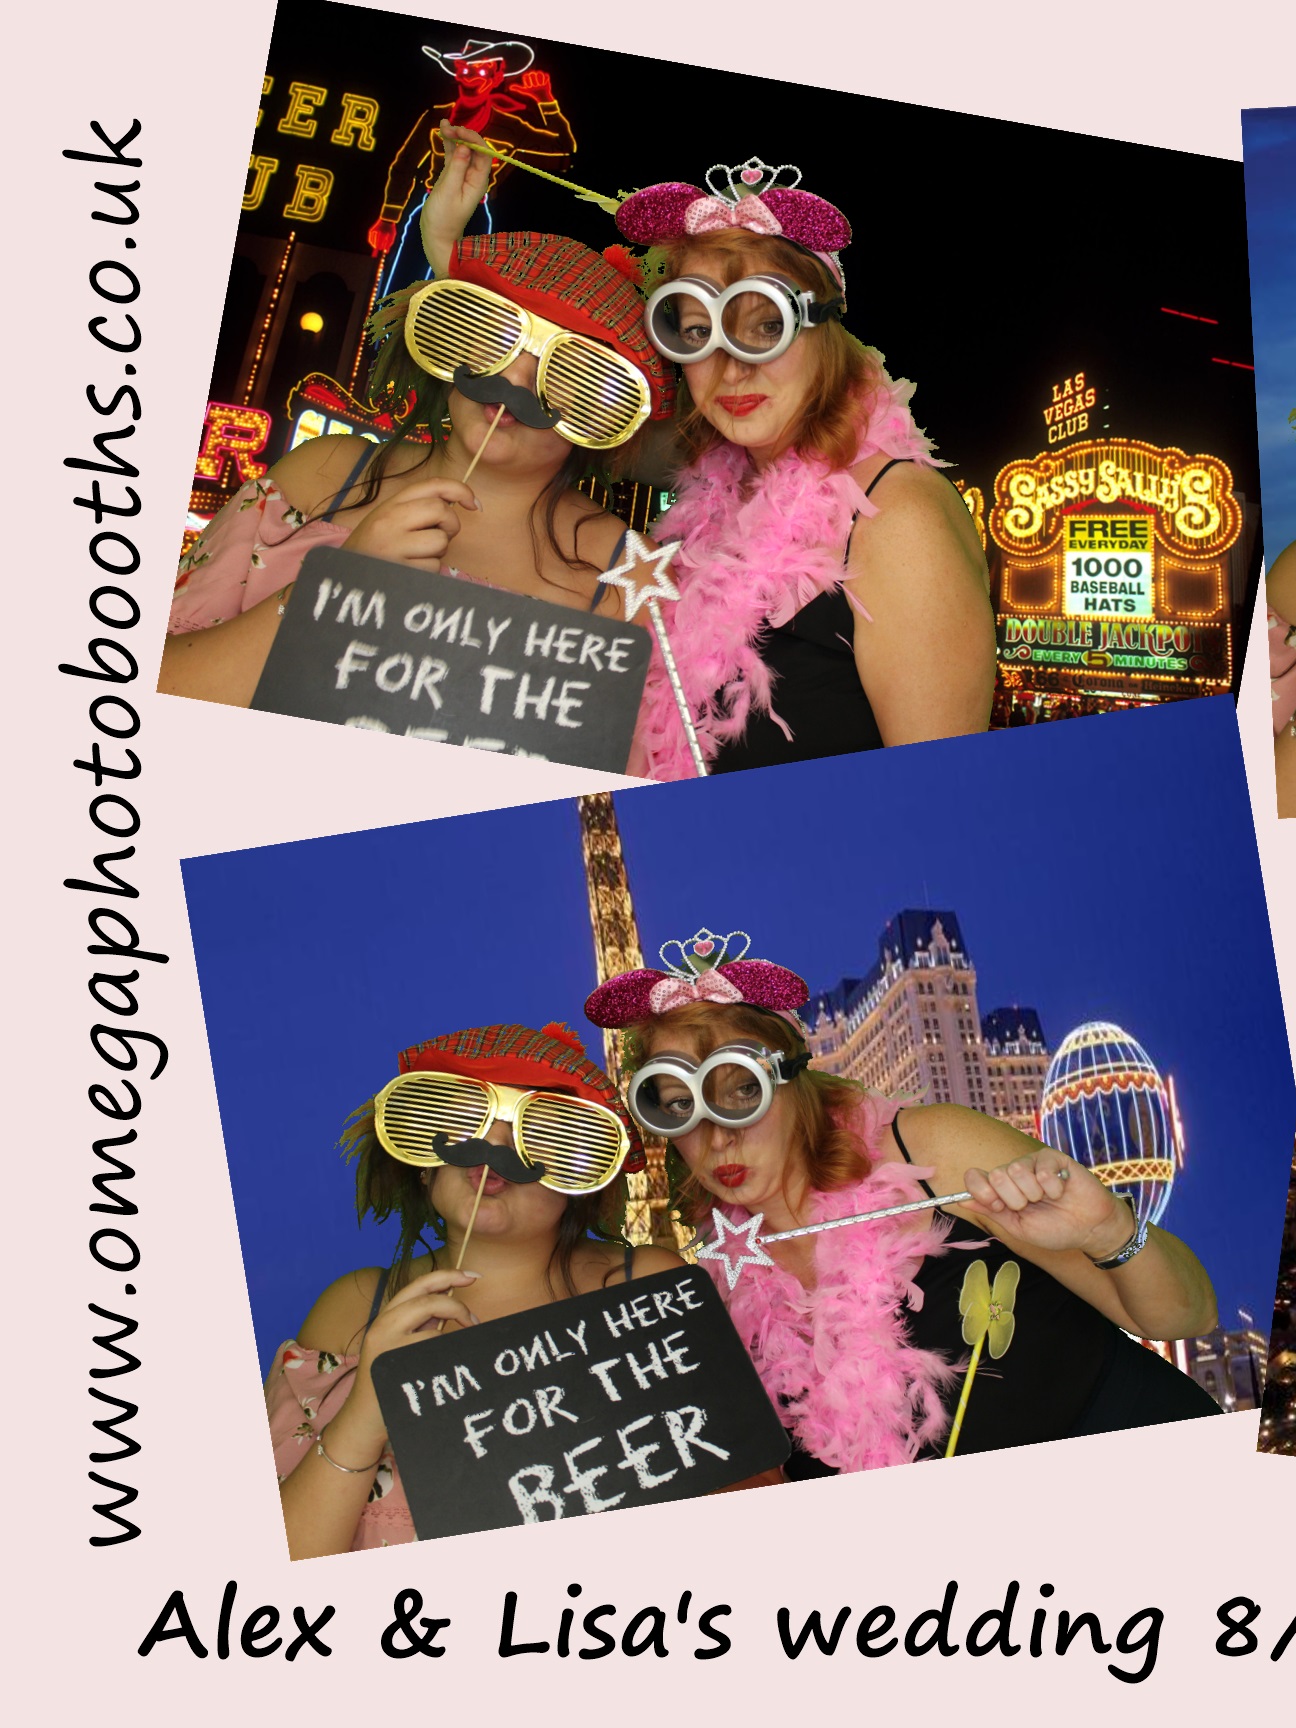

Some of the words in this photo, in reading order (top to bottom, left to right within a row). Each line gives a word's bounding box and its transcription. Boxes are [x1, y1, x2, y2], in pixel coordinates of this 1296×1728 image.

[256, 75, 380, 152] ER
[1052, 372, 1085, 403] LAS
[1043, 388, 1096, 426] VEGAS
[1048, 413, 1089, 444] CLUB
[1069, 519, 1148, 539] FREE
[1069, 540, 1148, 549] EVERYDAY
[1071, 557, 1143, 578] 1000
[1070, 581, 1145, 595] BASEBALL
[1084, 598, 1136, 612] HATS
[313, 577, 386, 629] I'M
[403, 602, 512, 655] ONLY
[523, 621, 635, 673] HERE
[1005, 618, 1093, 647] DOUBLE
[1032, 651, 1081, 664] EVERY
[1086, 650, 1112, 668] 5
[1113, 655, 1188, 671] MINUTES
[334, 639, 450, 710] FOR
[480, 664, 591, 728] THE
[401, 1364, 482, 1416] I'M
[494, 1320, 589, 1376] ONLY
[602, 1278, 704, 1338] HERE
[463, 1386, 579, 1458] FOR
[589, 1330, 700, 1401] THE
[508, 1405, 731, 1525] BEER
